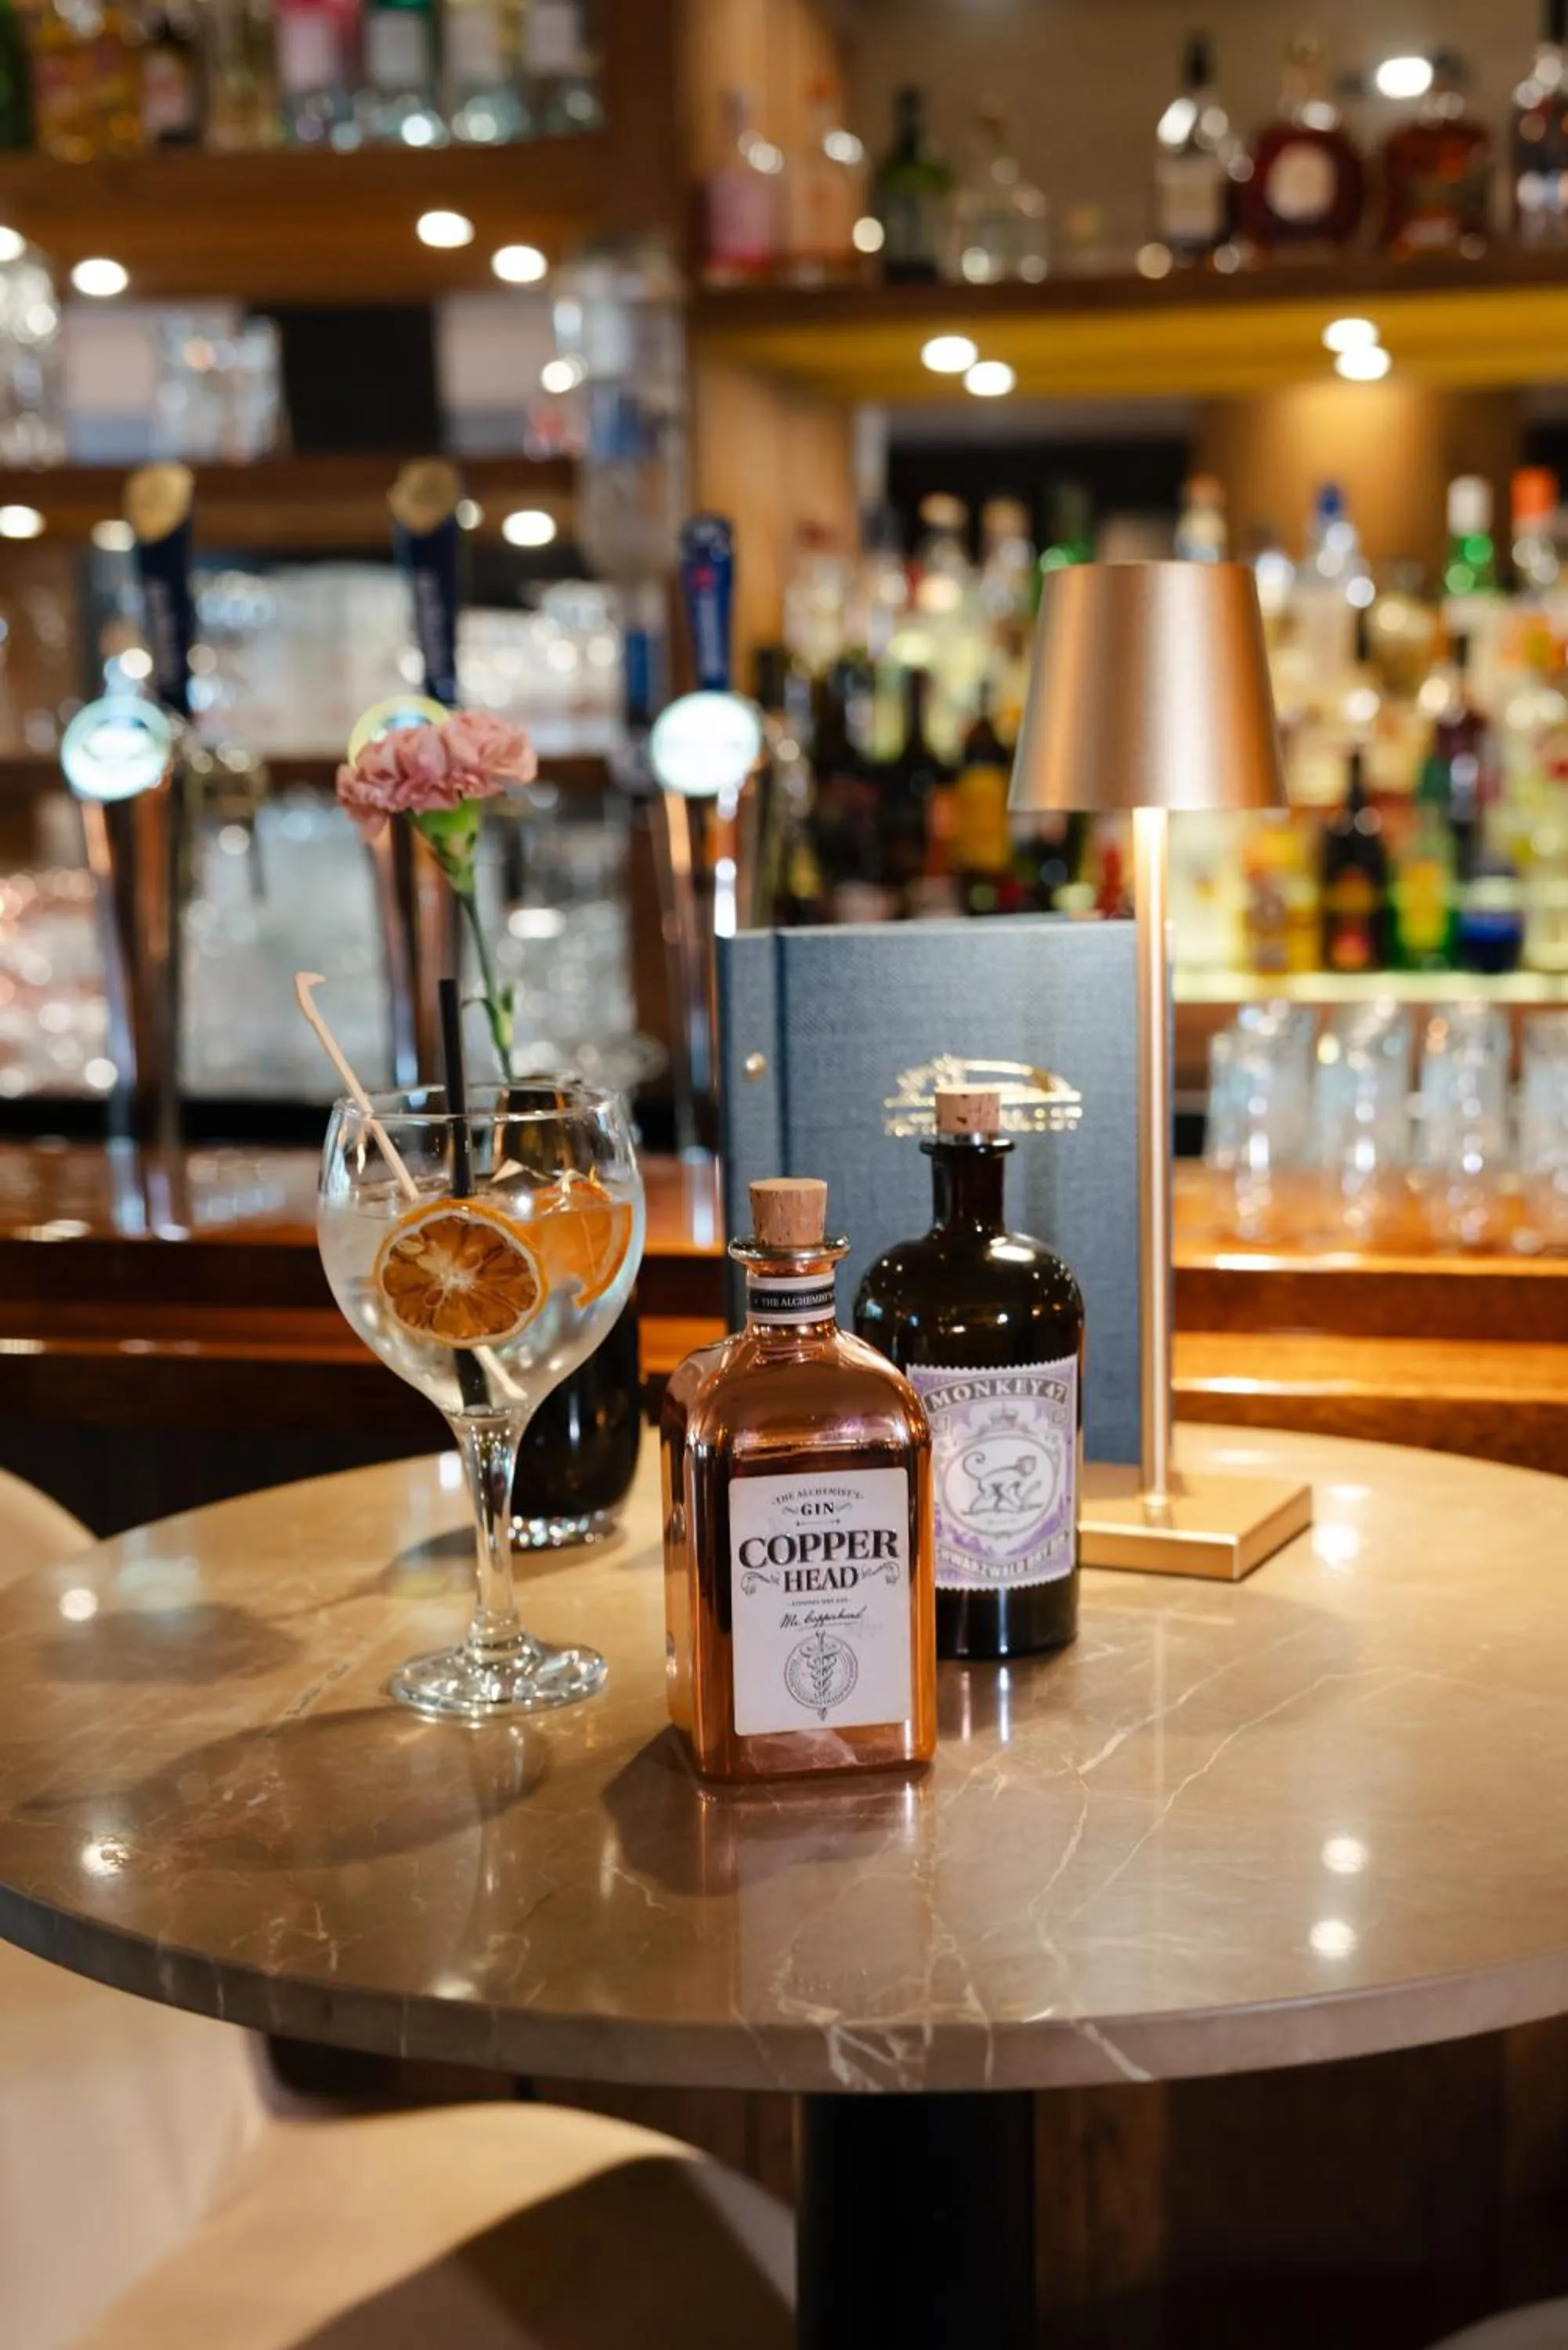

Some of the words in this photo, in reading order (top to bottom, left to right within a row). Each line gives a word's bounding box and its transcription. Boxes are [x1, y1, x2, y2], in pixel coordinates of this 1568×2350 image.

[761, 1296, 779, 1307] THE
[931, 1379, 1042, 1410] MONKEY
[1045, 1383, 1065, 1401] 47
[775, 1491, 793, 1505] THE
[800, 1501, 835, 1517] GIN
[739, 1529, 899, 1568] COPPER
[784, 1565, 859, 1593] HEAD
